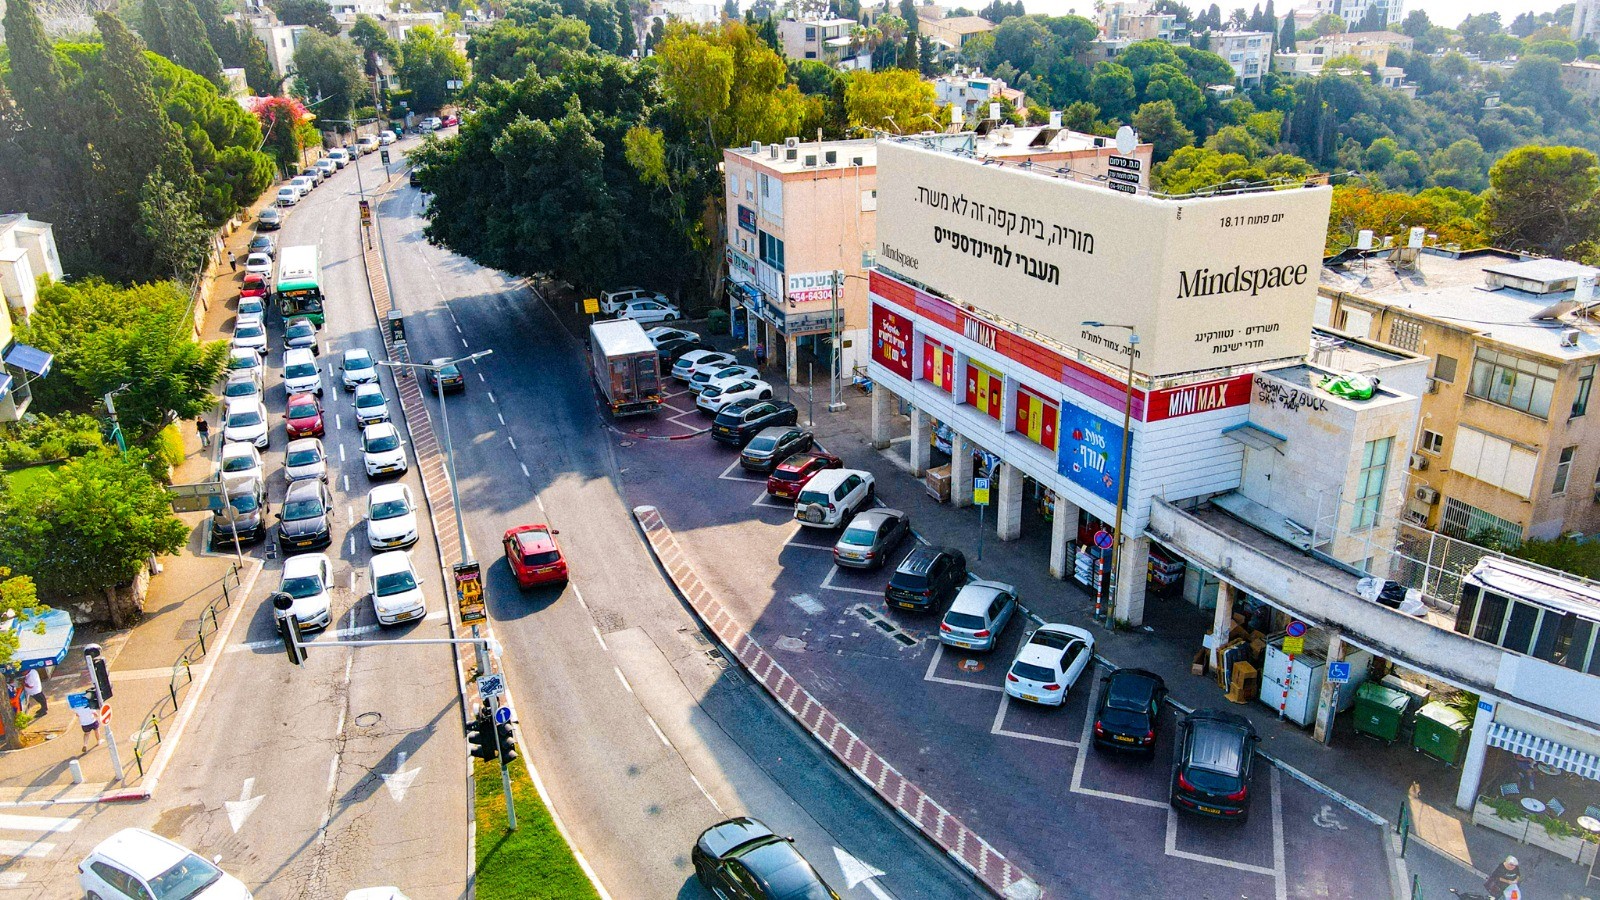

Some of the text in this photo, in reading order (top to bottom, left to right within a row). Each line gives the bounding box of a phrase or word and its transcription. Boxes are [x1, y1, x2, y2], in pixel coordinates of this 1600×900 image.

[914, 186, 1094, 254] מוריה, בית קפה זה לא משרד.
[1220, 213, 1284, 228] יום פתוח 18.11
[882, 241, 919, 270] Mindspace
[934, 226, 1060, 285] תעברי למיינדספייס
[1177, 263, 1308, 299] Mindspace
[791, 290, 843, 302] 054-643040
[979, 323, 997, 350] MAX
[1103, 338, 1120, 352] צמוד
[1195, 323, 1280, 343] משרדים נטוורקינג
[1213, 339, 1264, 354] חדרי ישיבות
[1197, 383, 1228, 411] MAX
[1299, 392, 1329, 412] BUCK
[1080, 444, 1106, 474] חורף
